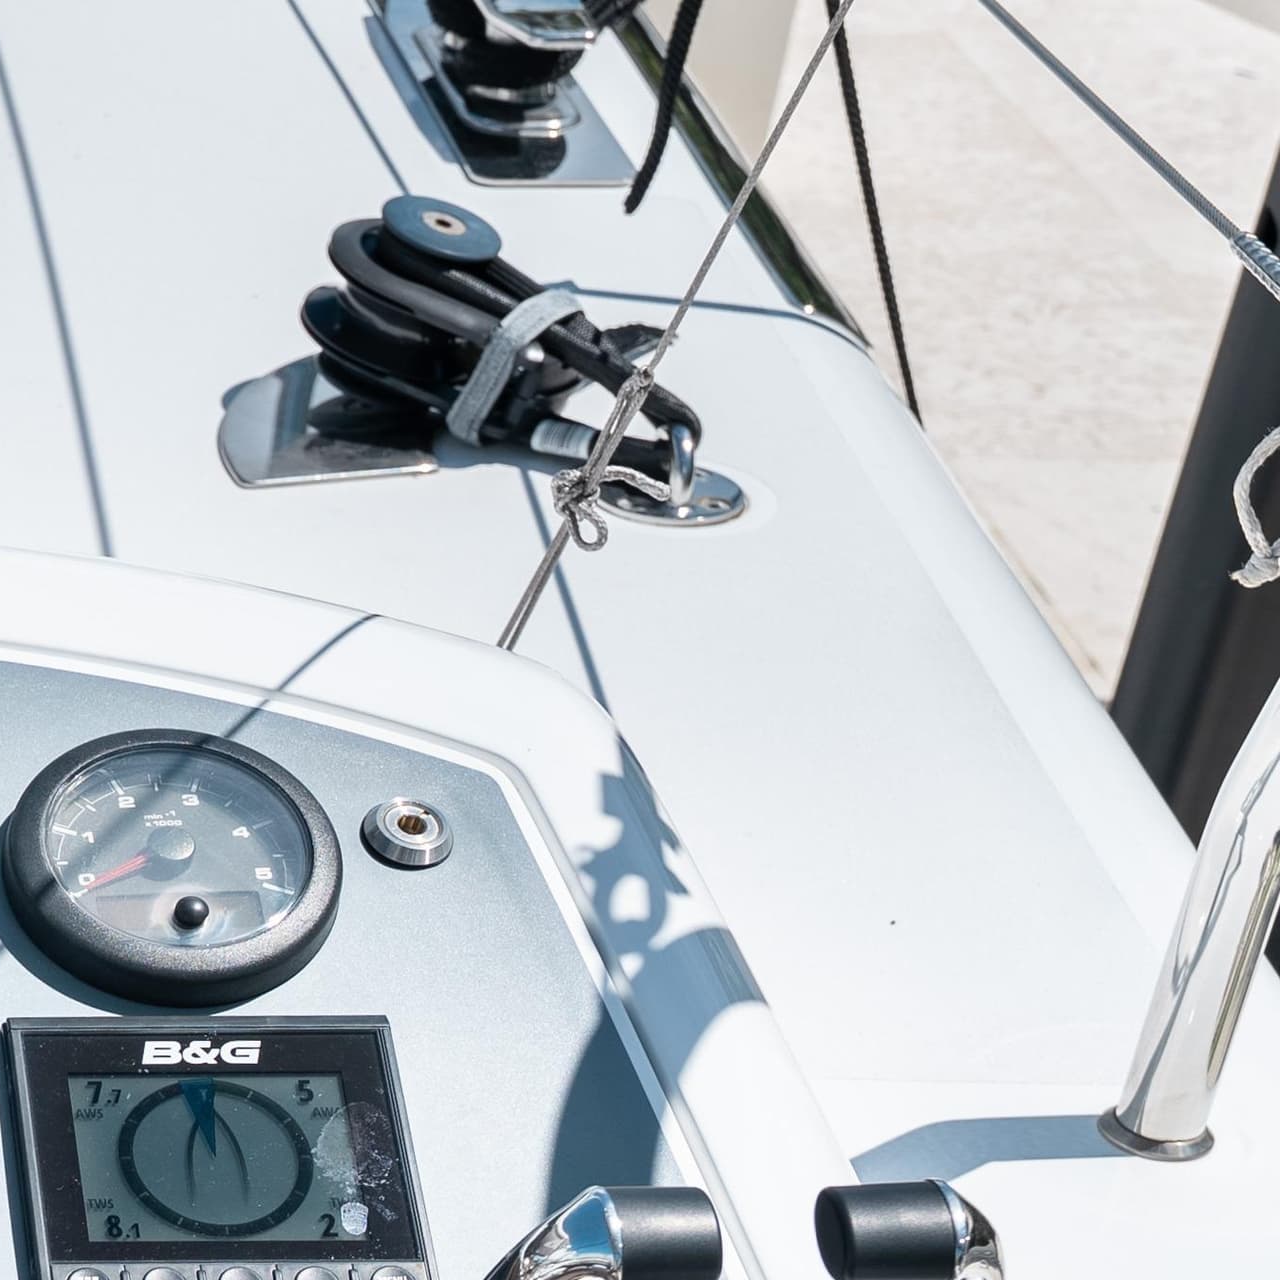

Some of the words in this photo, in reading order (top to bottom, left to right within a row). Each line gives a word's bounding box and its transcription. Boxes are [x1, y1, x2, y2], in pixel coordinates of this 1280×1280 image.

[118, 796, 136, 809] 2
[182, 794, 200, 806] 3
[82, 832, 95, 844] 1
[232, 826, 250, 839] 4
[78, 874, 96, 886] 0
[254, 867, 273, 880] 5
[141, 1040, 262, 1065] B&G
[84, 1080, 122, 1106] 7.7
[295, 1080, 314, 1106] 5
[75, 1108, 104, 1120] AWS
[87, 1198, 114, 1210] TWS
[106, 1215, 141, 1240] 8.1
[320, 1213, 338, 1238] 2
